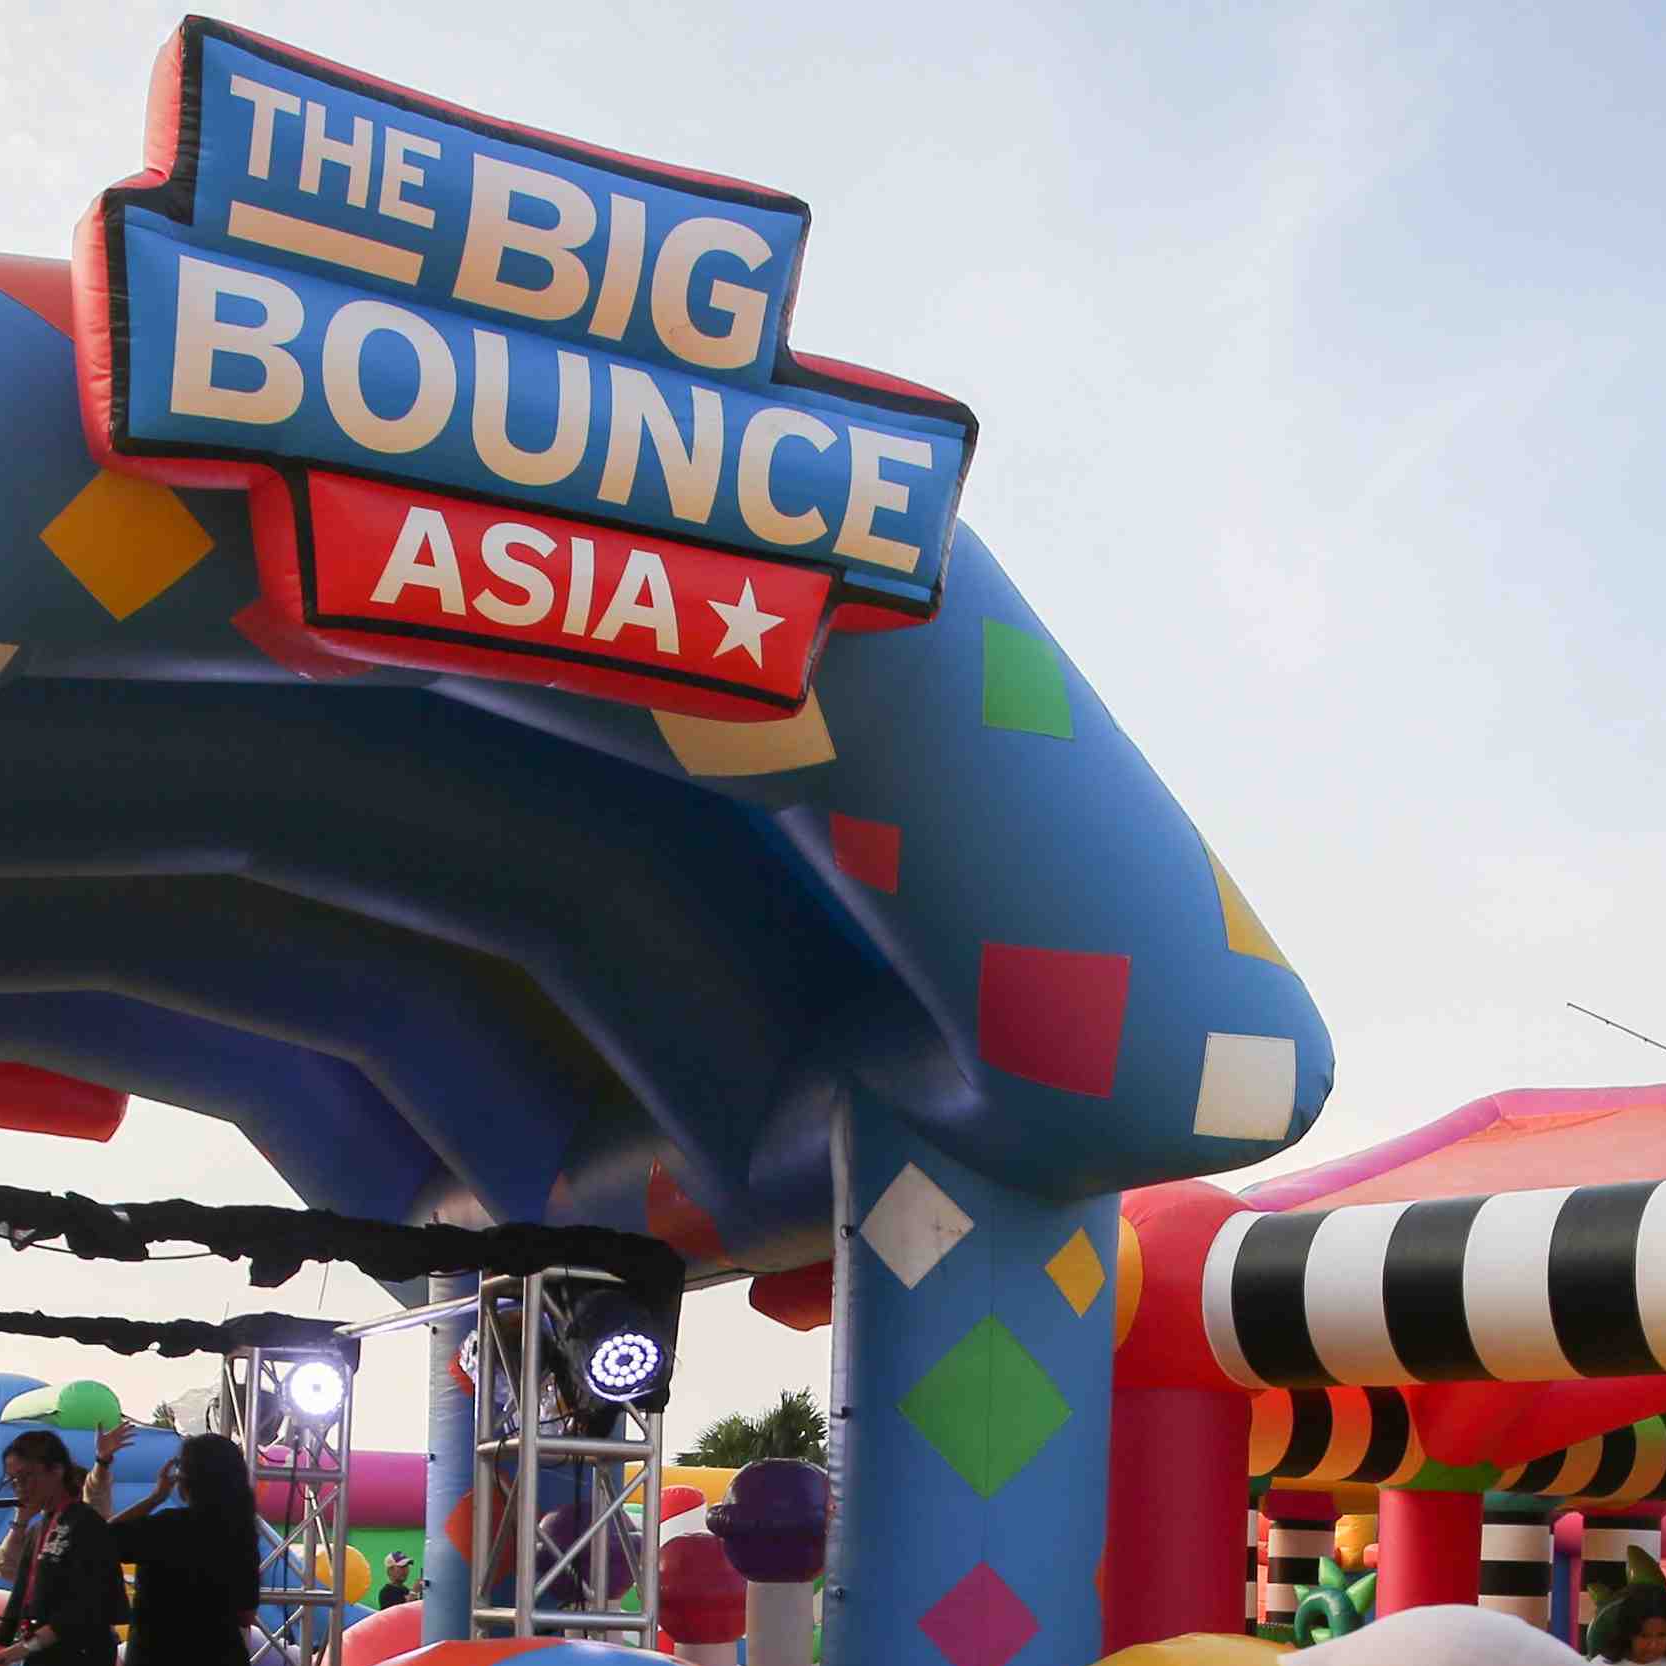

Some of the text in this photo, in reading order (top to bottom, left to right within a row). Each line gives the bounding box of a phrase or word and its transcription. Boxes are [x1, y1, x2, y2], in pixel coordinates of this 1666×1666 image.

[229, 73, 773, 370] THE BIG
[170, 254, 933, 574] BOUNCE
[369, 506, 682, 655] ASIA
